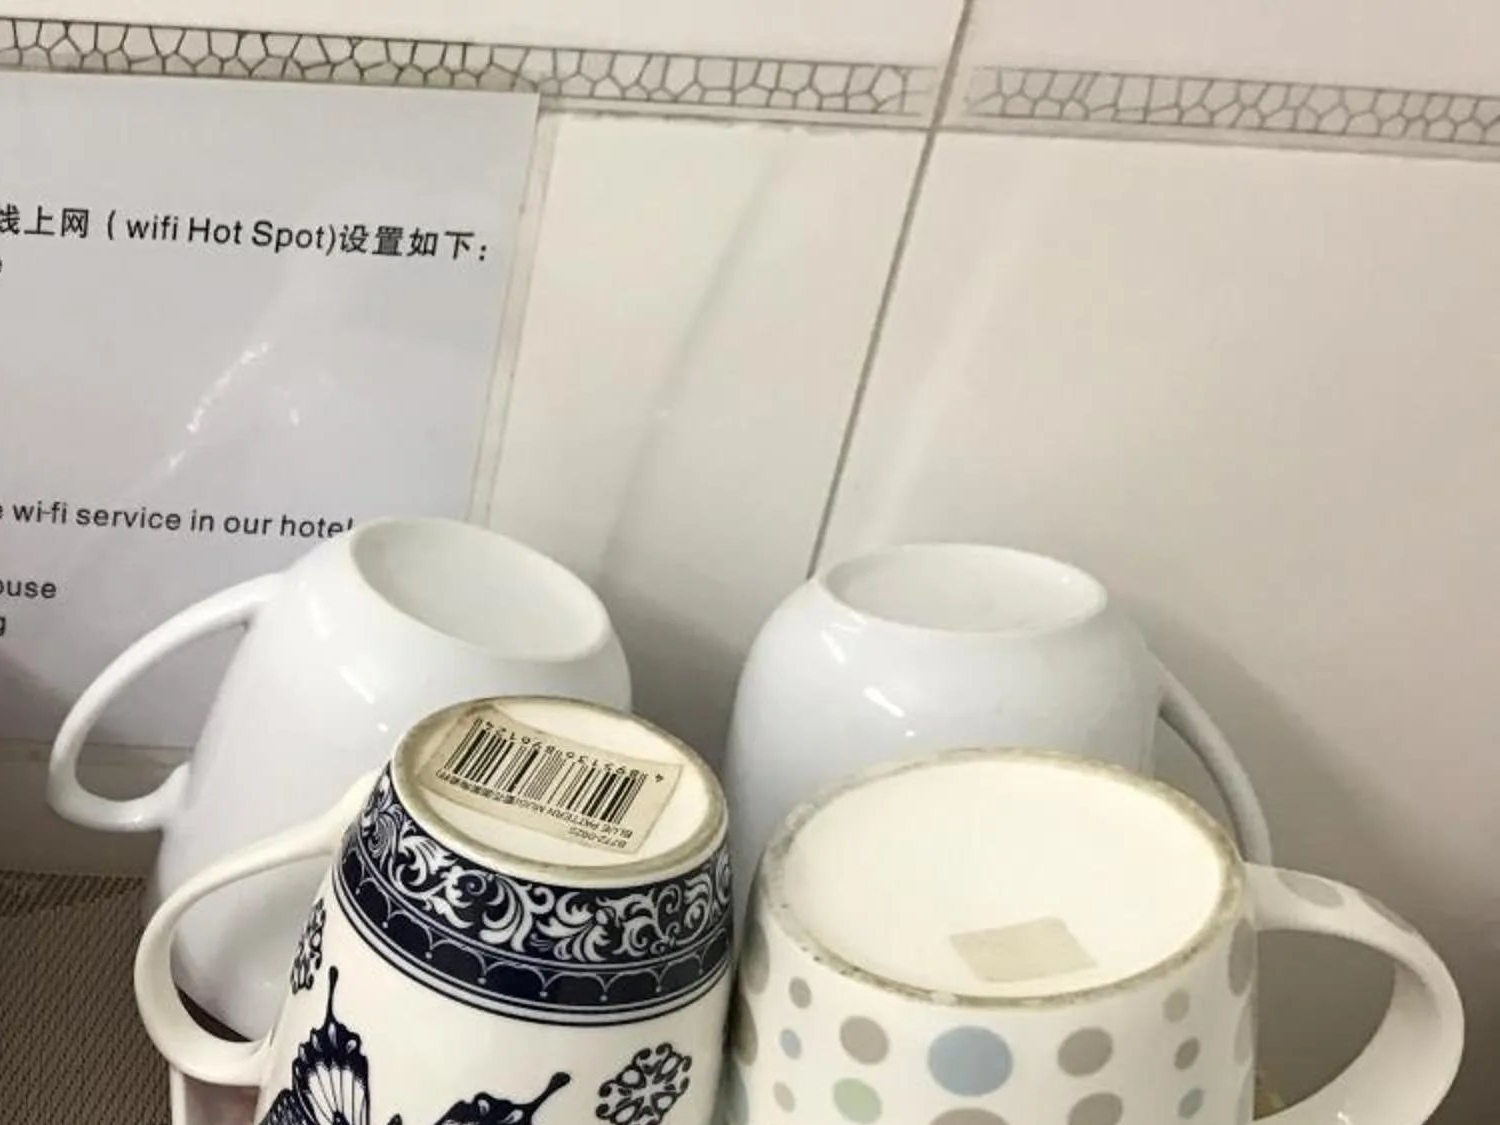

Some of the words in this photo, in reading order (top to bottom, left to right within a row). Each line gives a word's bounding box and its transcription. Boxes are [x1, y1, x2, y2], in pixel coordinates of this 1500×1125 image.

[188, 217, 243, 245] Hot
[76, 506, 181, 531] service
[190, 509, 215, 532] in
[223, 516, 273, 535] our
